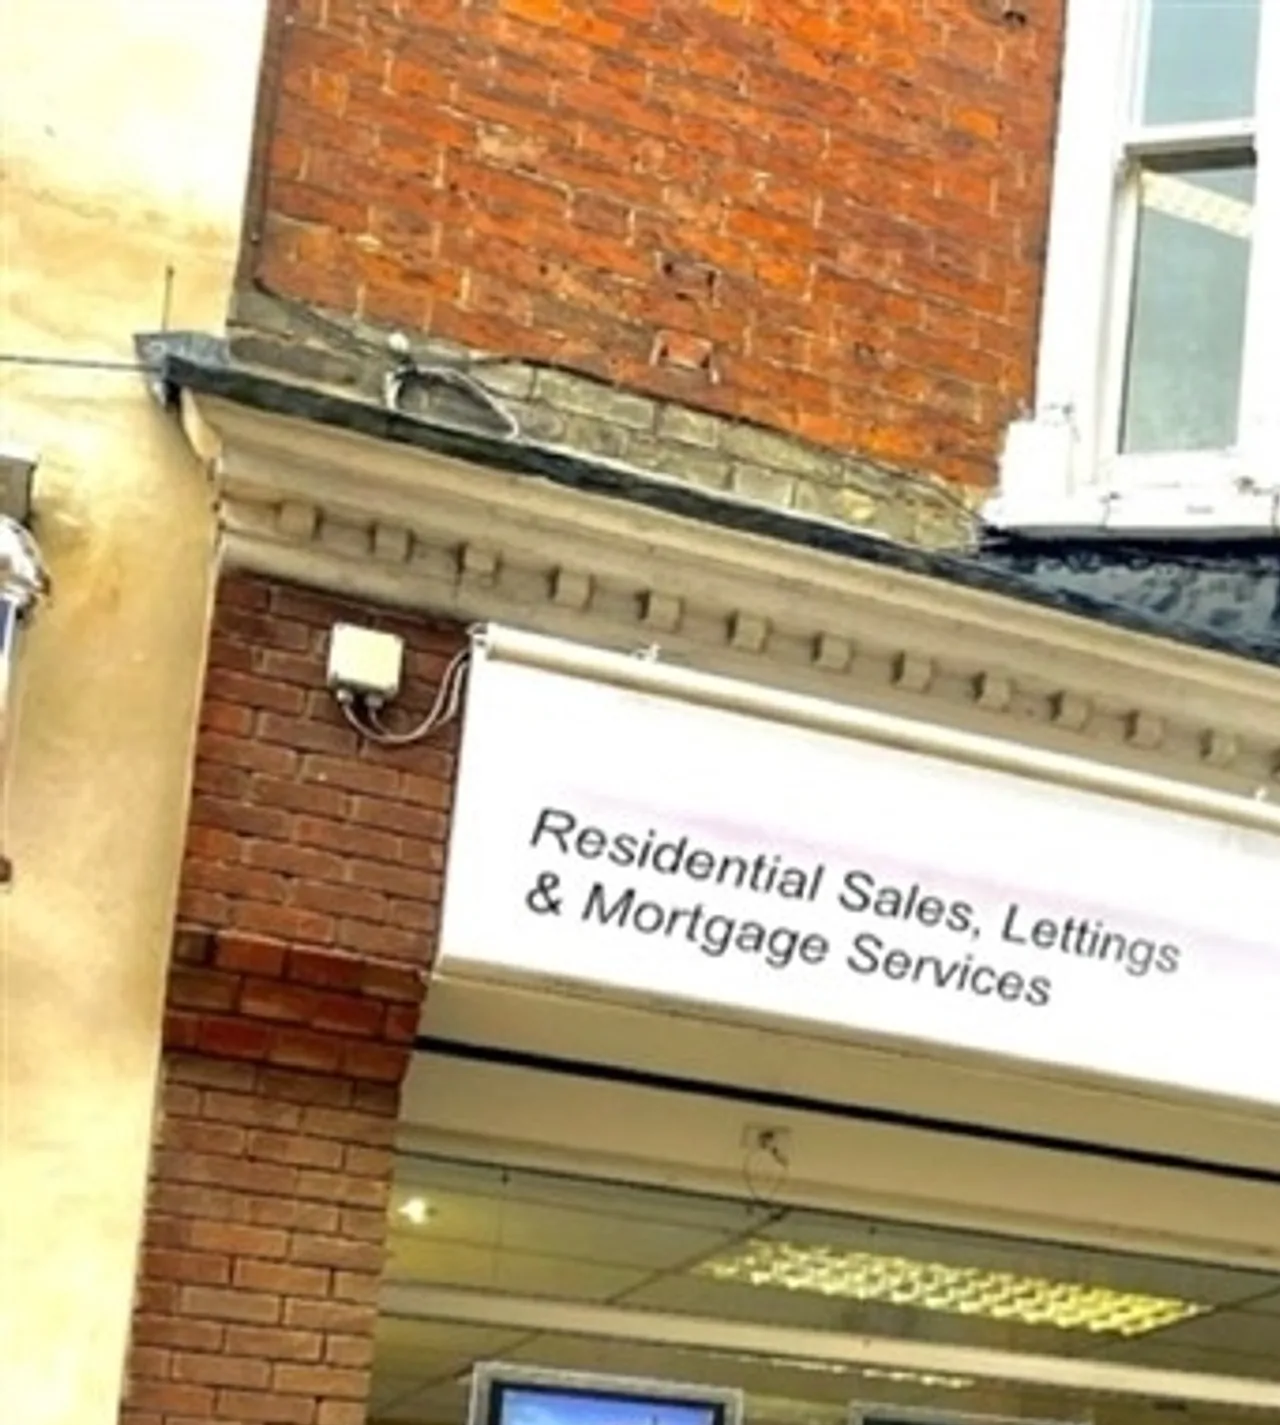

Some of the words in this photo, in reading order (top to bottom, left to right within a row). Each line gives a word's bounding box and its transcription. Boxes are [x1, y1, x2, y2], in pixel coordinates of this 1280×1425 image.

[525, 871, 563, 916] &
[581, 881, 830, 970] Mortgage
[847, 932, 1052, 1007] Services
[530, 806, 826, 902] Residential
[838, 869, 981, 941] Sales,
[1001, 902, 1182, 978] Lettings
